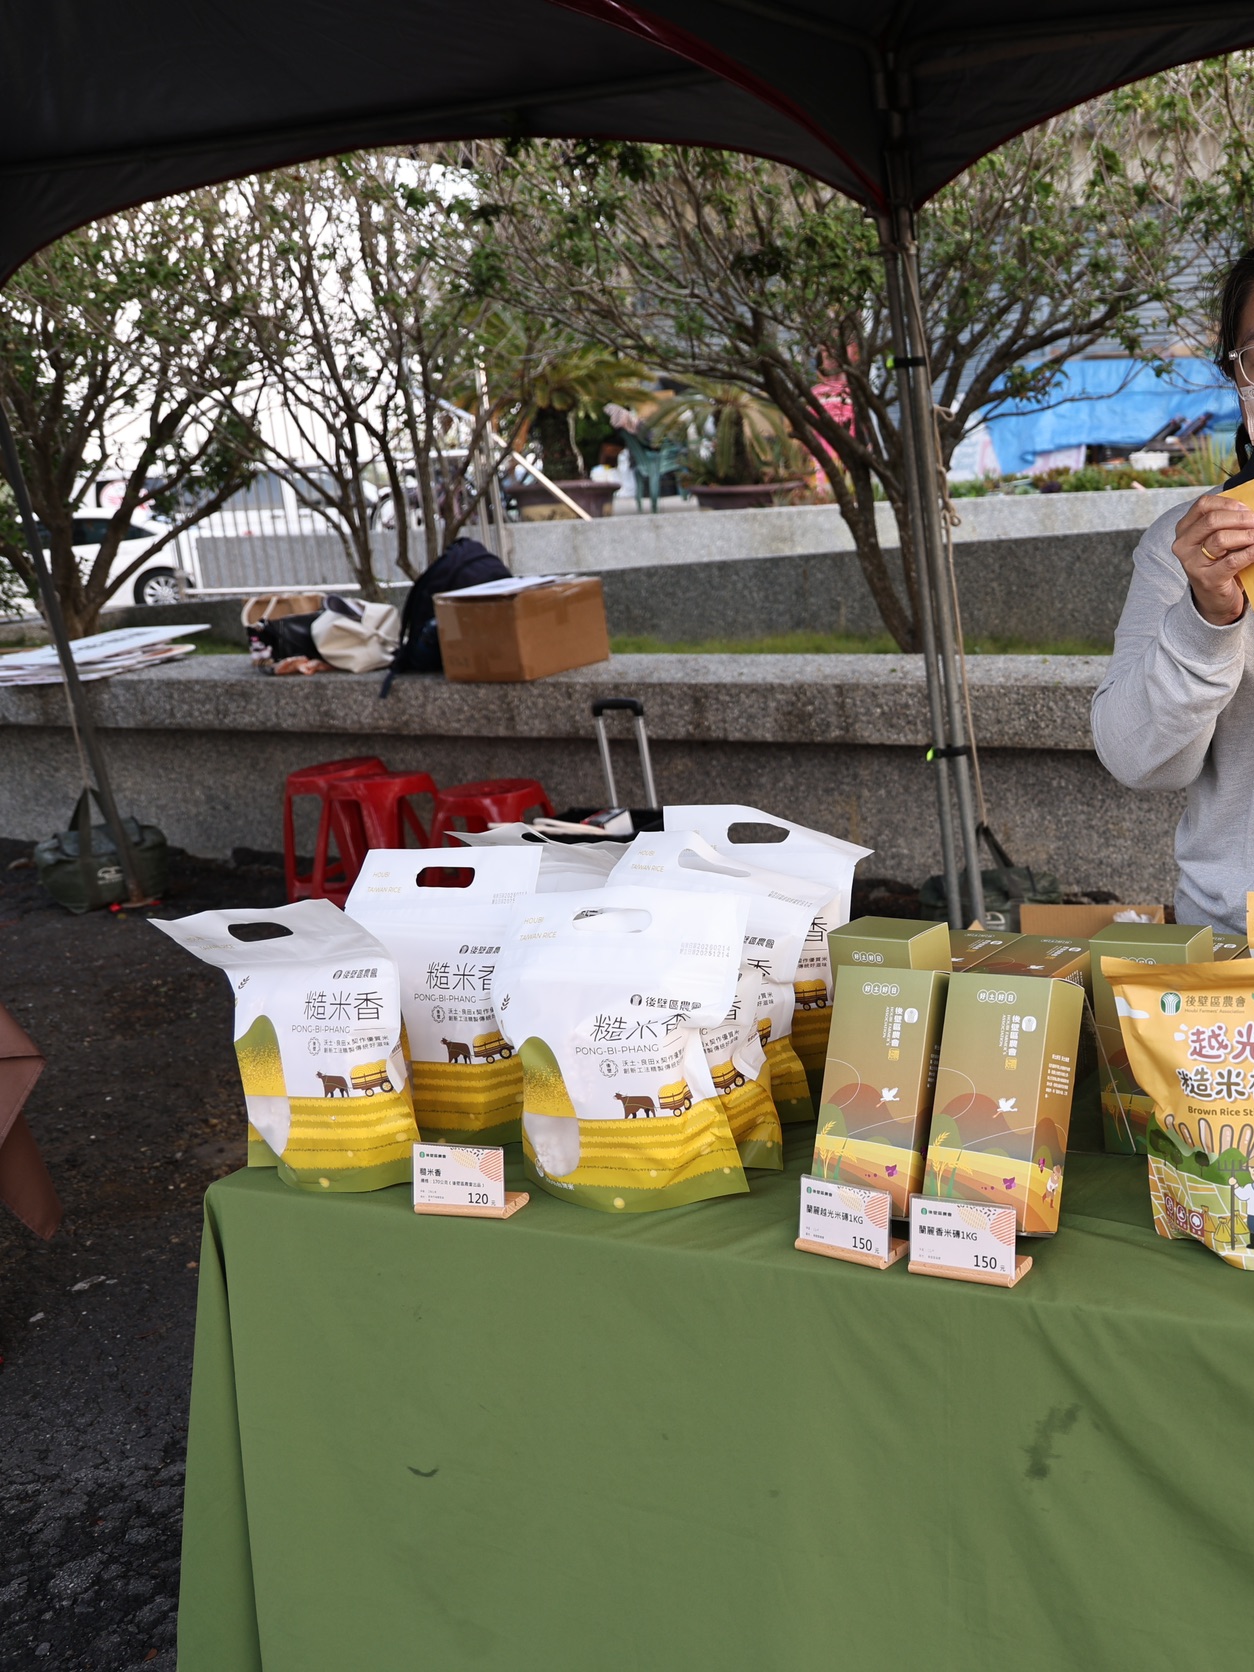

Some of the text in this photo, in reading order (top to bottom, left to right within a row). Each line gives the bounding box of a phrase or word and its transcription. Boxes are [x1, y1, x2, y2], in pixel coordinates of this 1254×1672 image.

[470, 946, 501, 955] 後壁區農
[343, 968, 378, 978] 後壁區農會
[864, 984, 898, 995] 好土好日
[414, 993, 477, 1003] PONG-BI-PHANG
[978, 991, 1015, 1003] 好土好日
[1185, 995, 1246, 1008] 後壁區農會
[304, 991, 384, 1020] 糙米香
[292, 1025, 351, 1034] PONG-BI-PHANG
[891, 1006, 903, 1047] 後壁區農會
[1008, 1015, 1021, 1056] 後壁區農會
[575, 1044, 659, 1056] PONG-BI-PHANG
[1188, 1106, 1217, 1116] Brown
[1220, 1107, 1240, 1116] Rice
[420, 1168, 441, 1177] 糙米香
[468, 1192, 489, 1205] 120
[813, 1189, 833, 1197] 後壁區農會
[852, 1236, 873, 1252] 150
[973, 1254, 997, 1270] 150
